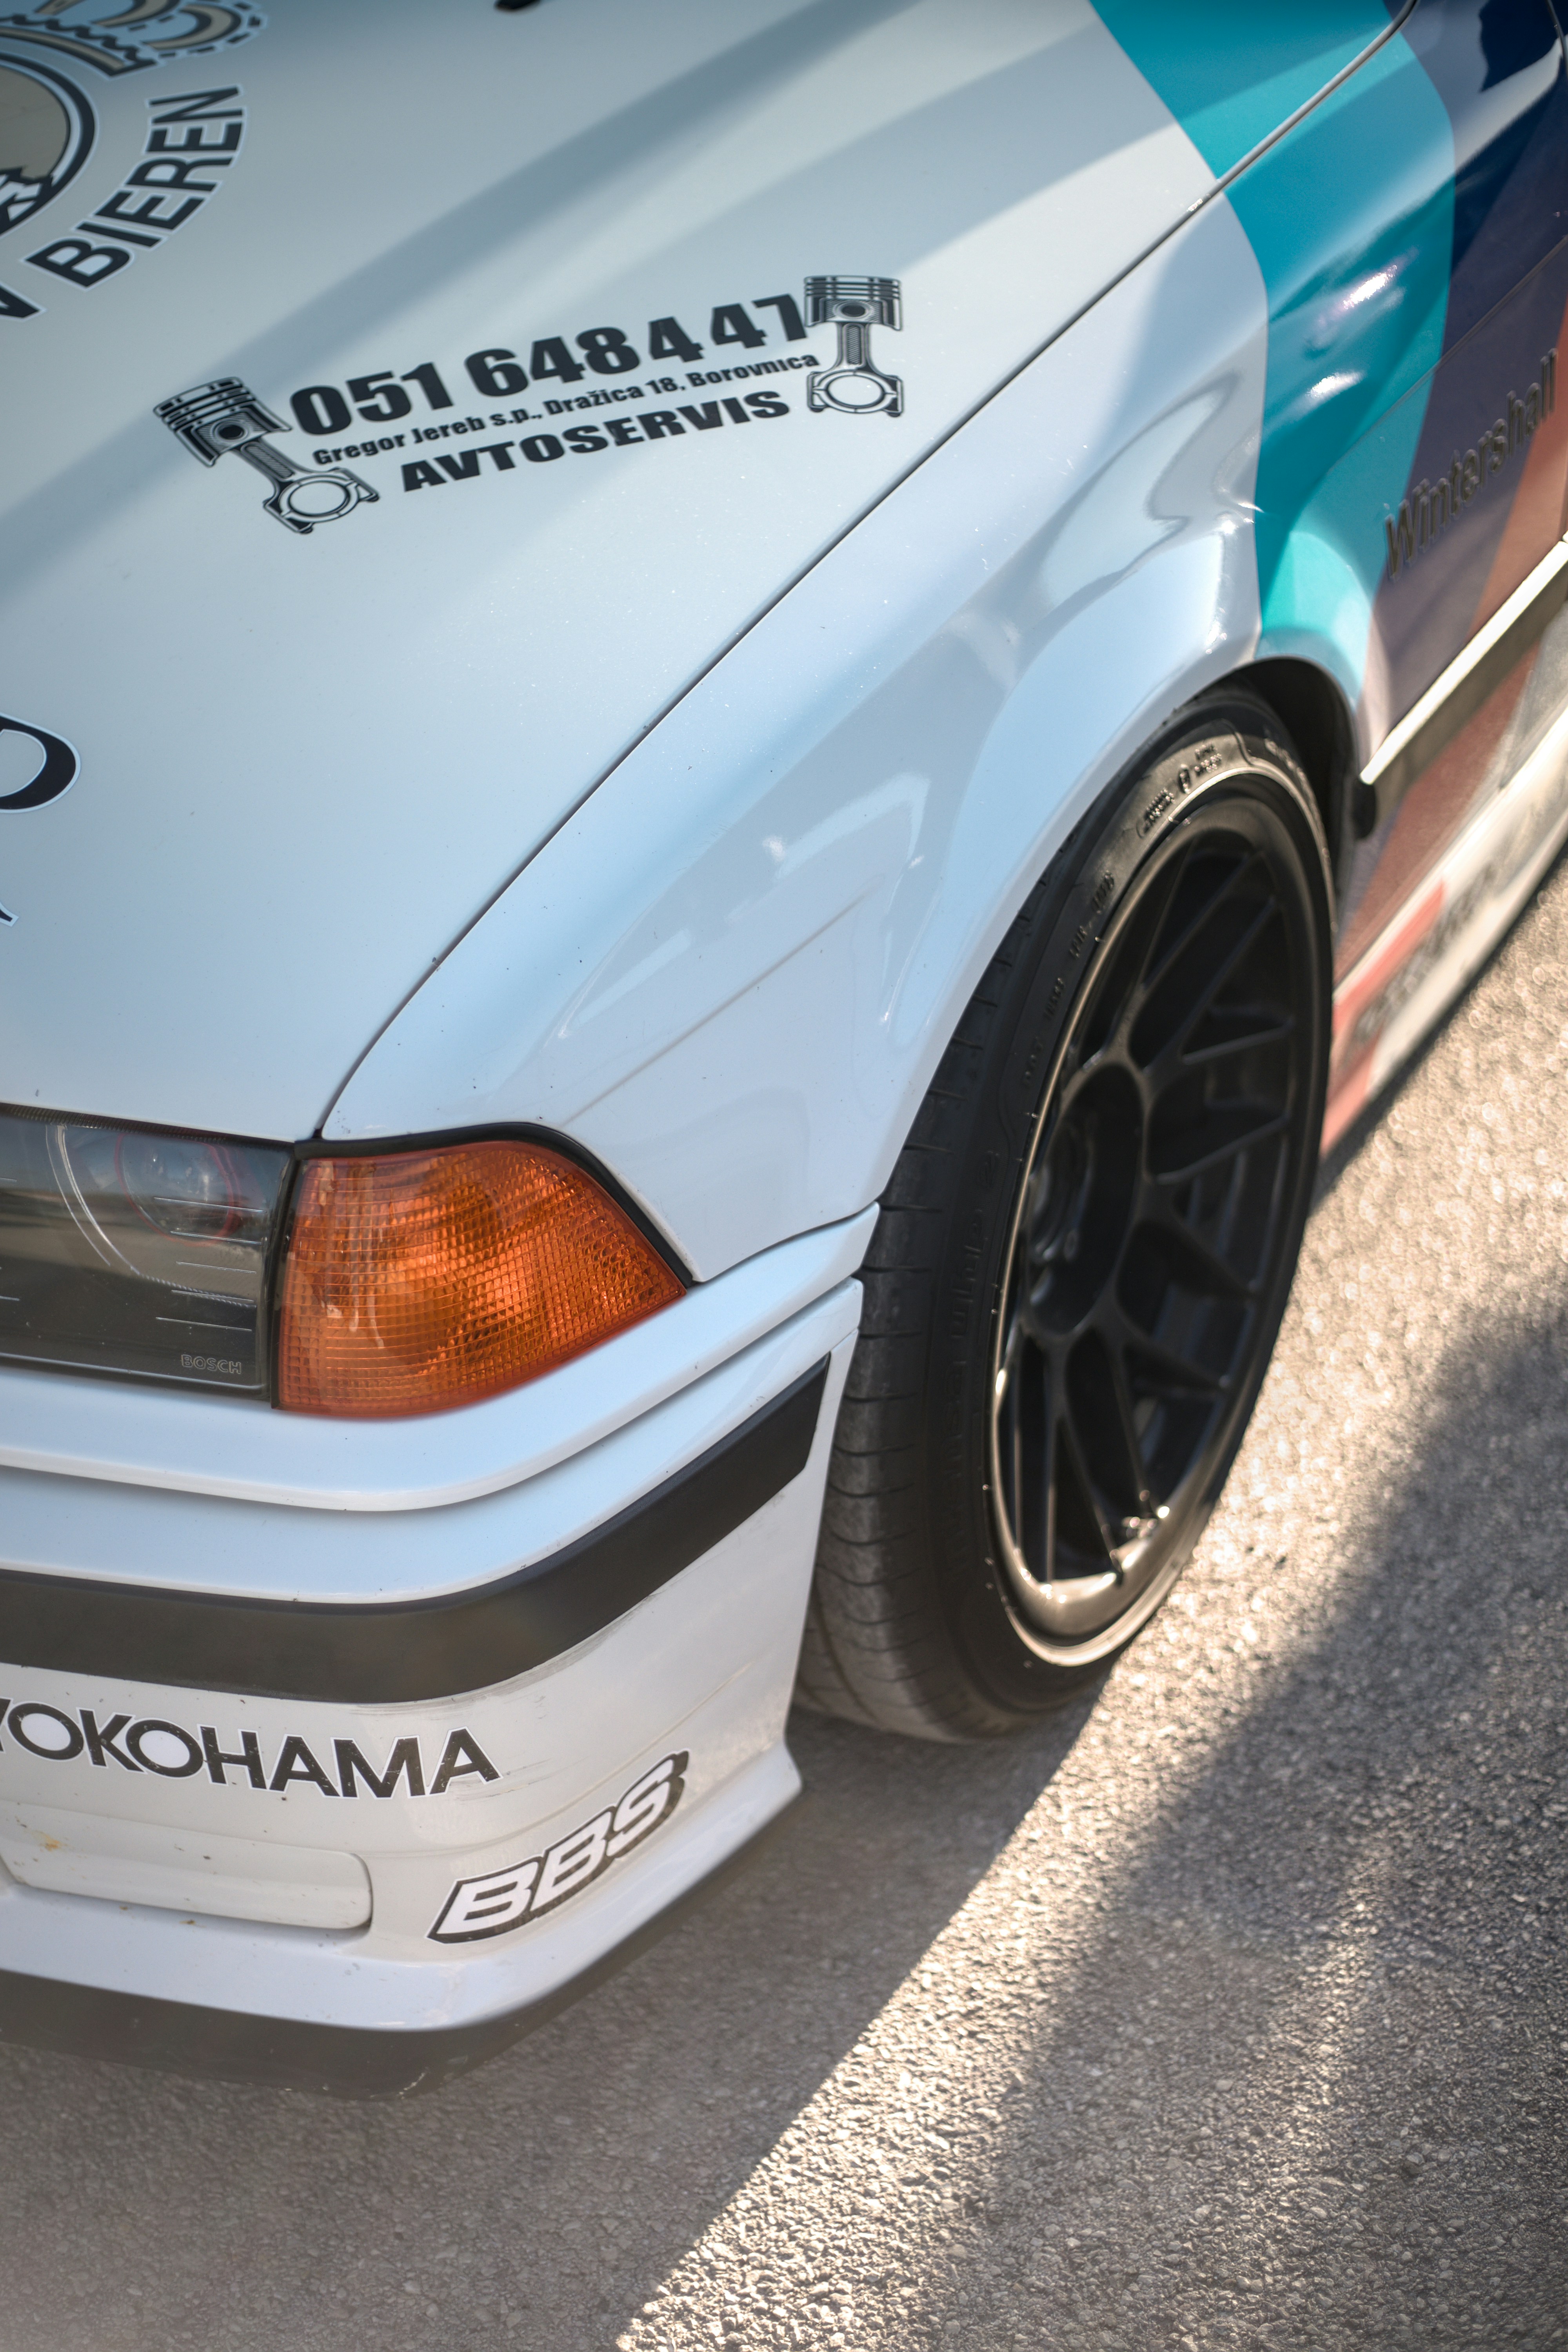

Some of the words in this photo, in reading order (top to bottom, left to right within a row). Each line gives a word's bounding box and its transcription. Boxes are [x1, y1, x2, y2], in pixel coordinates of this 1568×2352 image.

[24, 85, 244, 288] BIEREN
[289, 361, 454, 435] 051
[312, 433, 406, 465] Gregor
[411, 416, 486, 445] Jereb
[542, 385, 645, 416] Dražica
[645, 376, 686, 394] 18,
[401, 390, 790, 493] AVTOSERVIS
[1384, 347, 1558, 583] Wintershall
[181, 1354, 242, 1375] BOSCH
[0, 1698, 502, 1798] OKOHAMA
[426, 1749, 689, 1945] BBS
